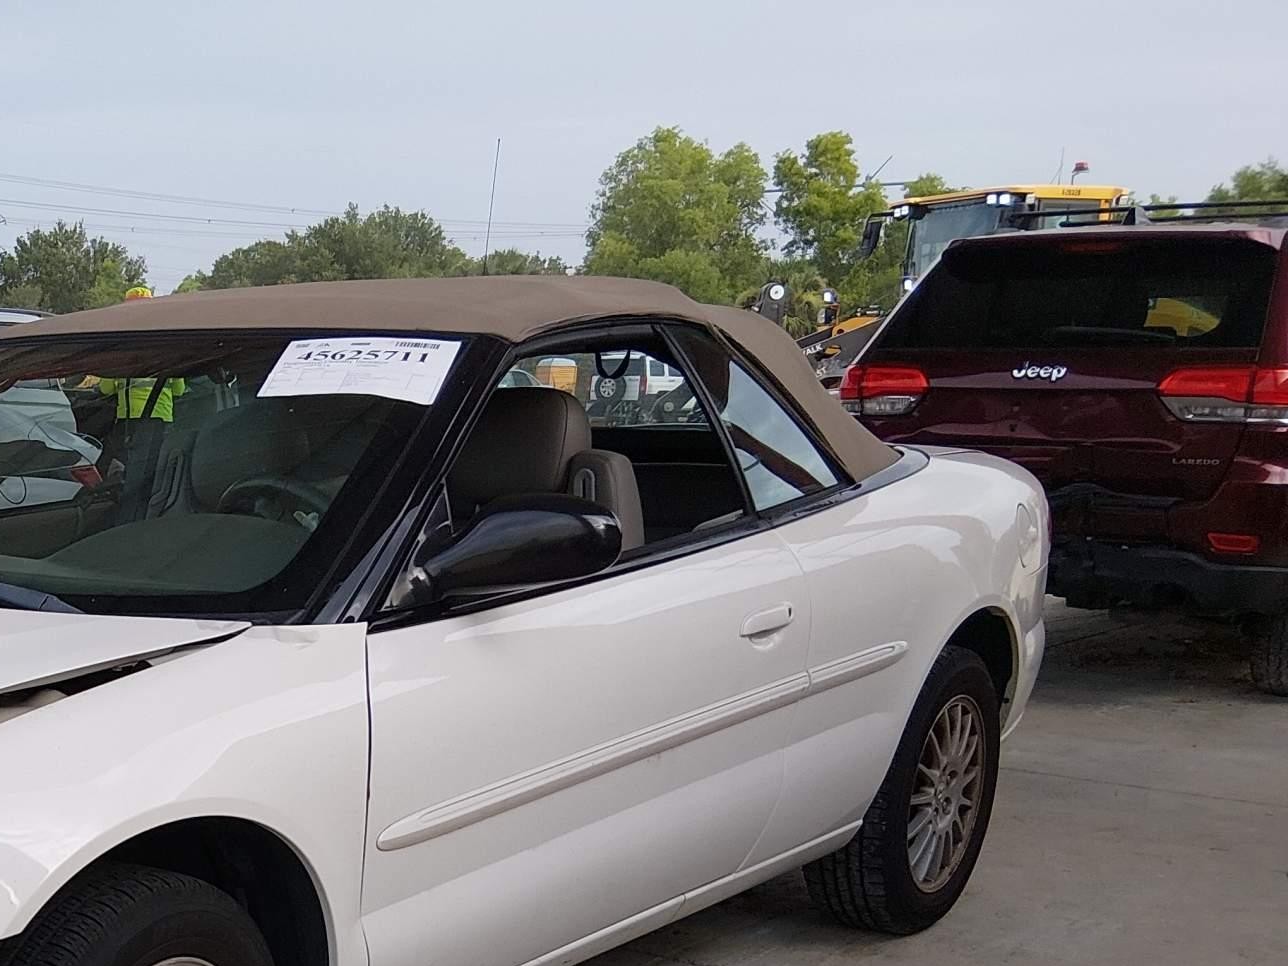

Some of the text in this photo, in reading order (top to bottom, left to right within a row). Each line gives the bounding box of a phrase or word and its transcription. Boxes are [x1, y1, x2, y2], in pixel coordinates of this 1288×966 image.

[296, 349, 430, 363] 45625711
[1012, 361, 1067, 381] Jeep
[1171, 458, 1221, 466] LAREDO
